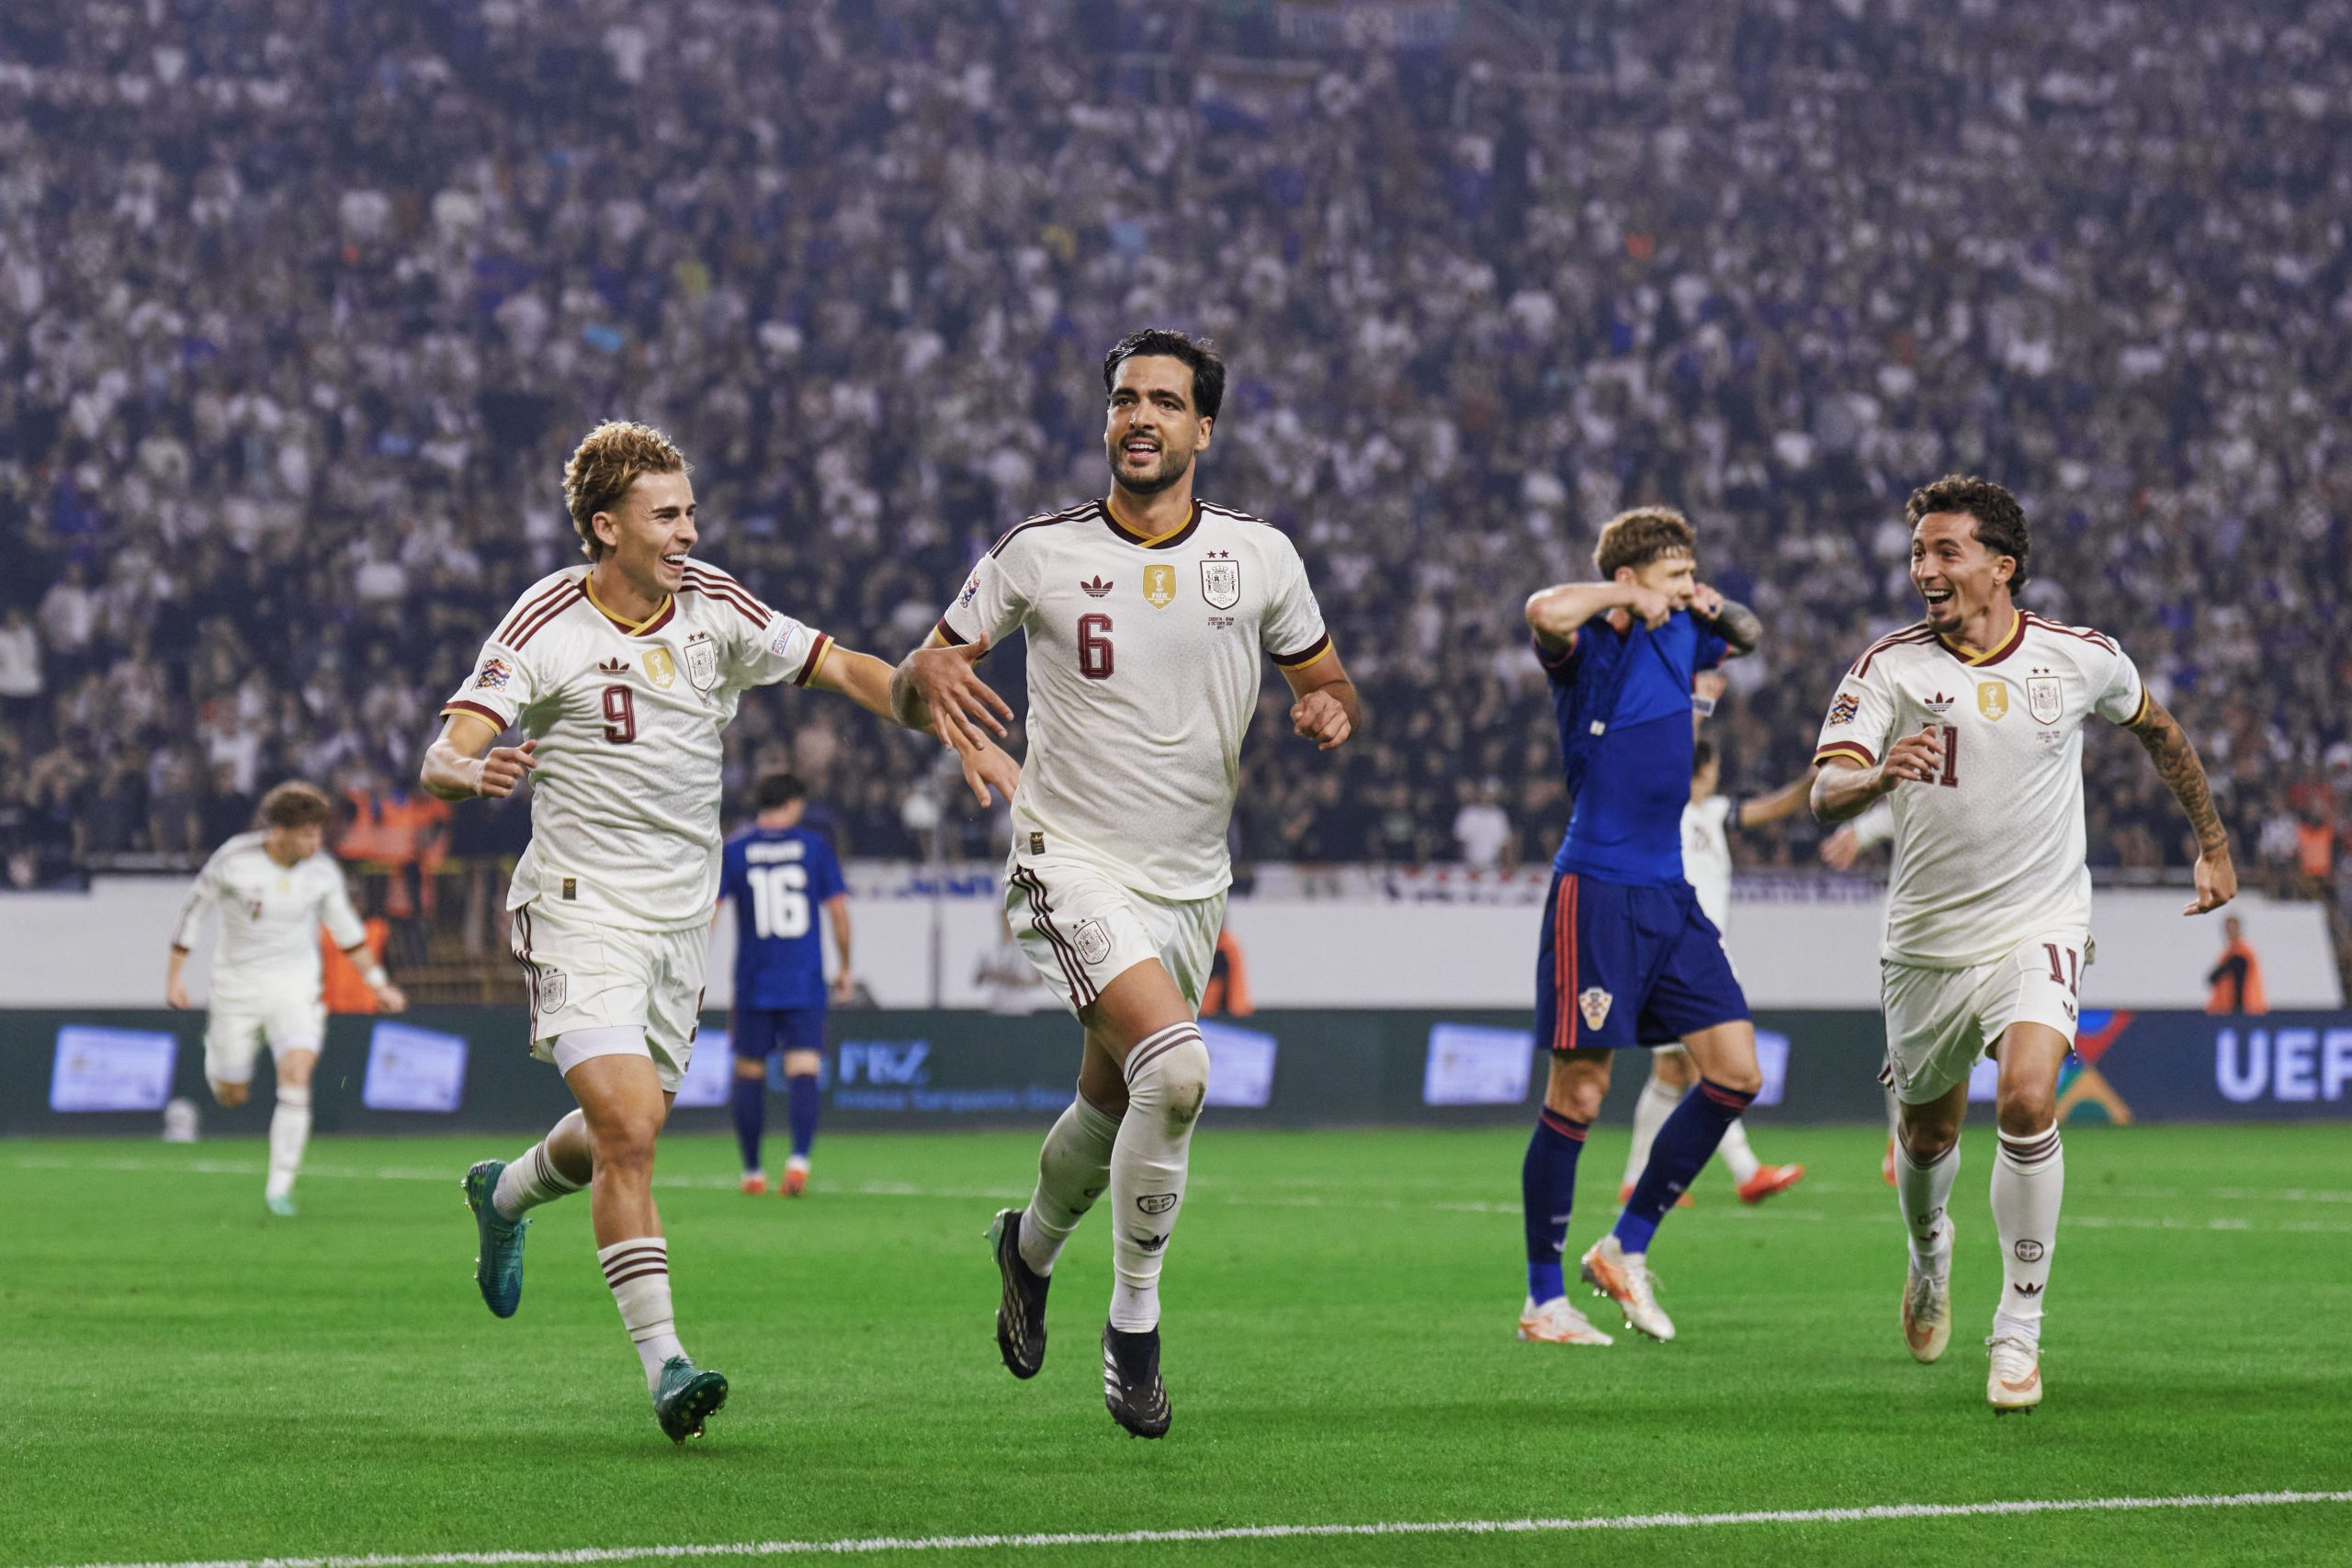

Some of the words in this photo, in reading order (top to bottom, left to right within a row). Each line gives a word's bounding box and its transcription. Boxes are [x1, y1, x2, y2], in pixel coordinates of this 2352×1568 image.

[1077, 614, 1114, 680] 6
[603, 684, 636, 744] 9
[747, 865, 809, 939] 16
[2041, 942, 2077, 999] 11
[2215, 1027, 2352, 1102] UEF
